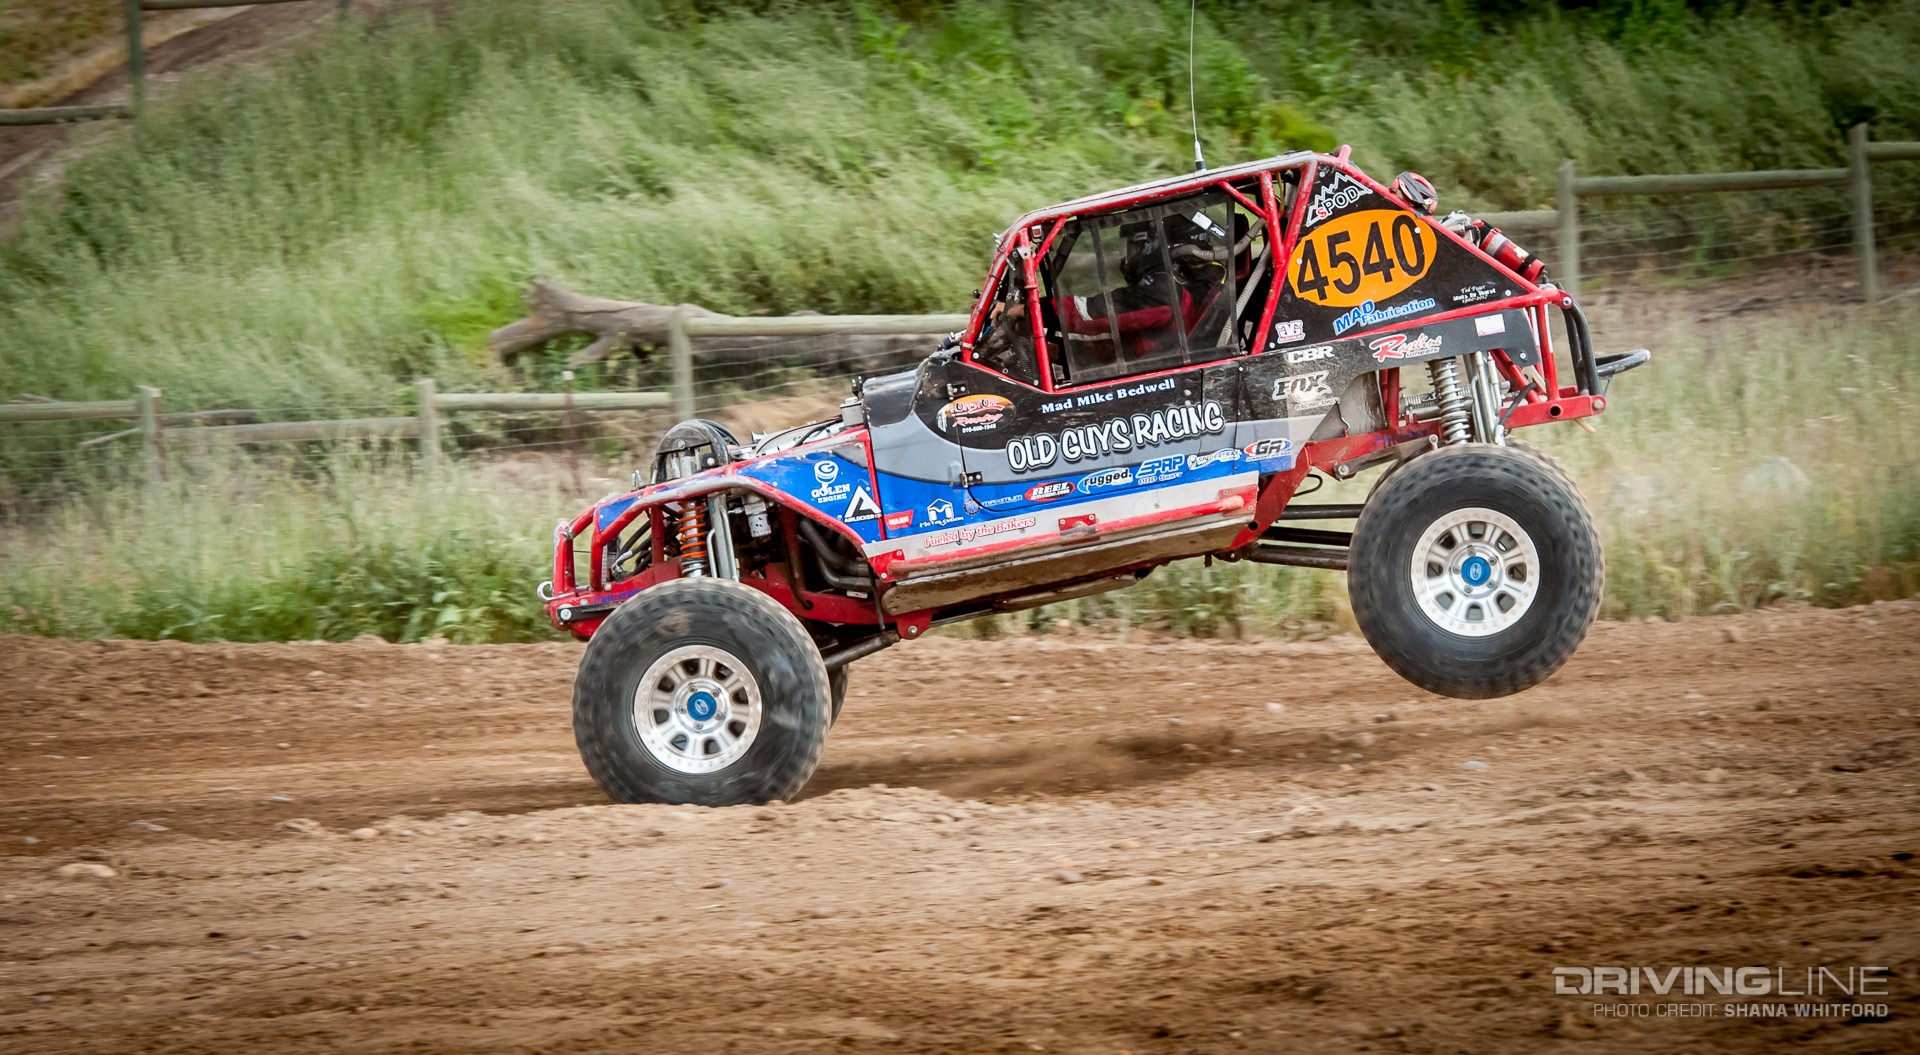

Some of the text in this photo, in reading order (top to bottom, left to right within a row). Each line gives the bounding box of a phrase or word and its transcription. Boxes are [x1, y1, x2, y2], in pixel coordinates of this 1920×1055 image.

[1297, 215, 1426, 301] 4540
[1335, 301, 1374, 332] MAD
[1361, 299, 1435, 324] Fabrication
[1287, 345, 1334, 364] CBR
[1371, 334, 1441, 360] Raceline
[1041, 378, 1176, 414] Mad Mike Bedwell
[1275, 372, 1331, 398] FOX
[1007, 401, 1224, 470] OLD GUYS RACING
[811, 484, 851, 498] GOLEN
[818, 493, 847, 503] ENGINE
[1032, 482, 1069, 496] REEL
[925, 517, 1036, 547] Fueled by the Bakers
